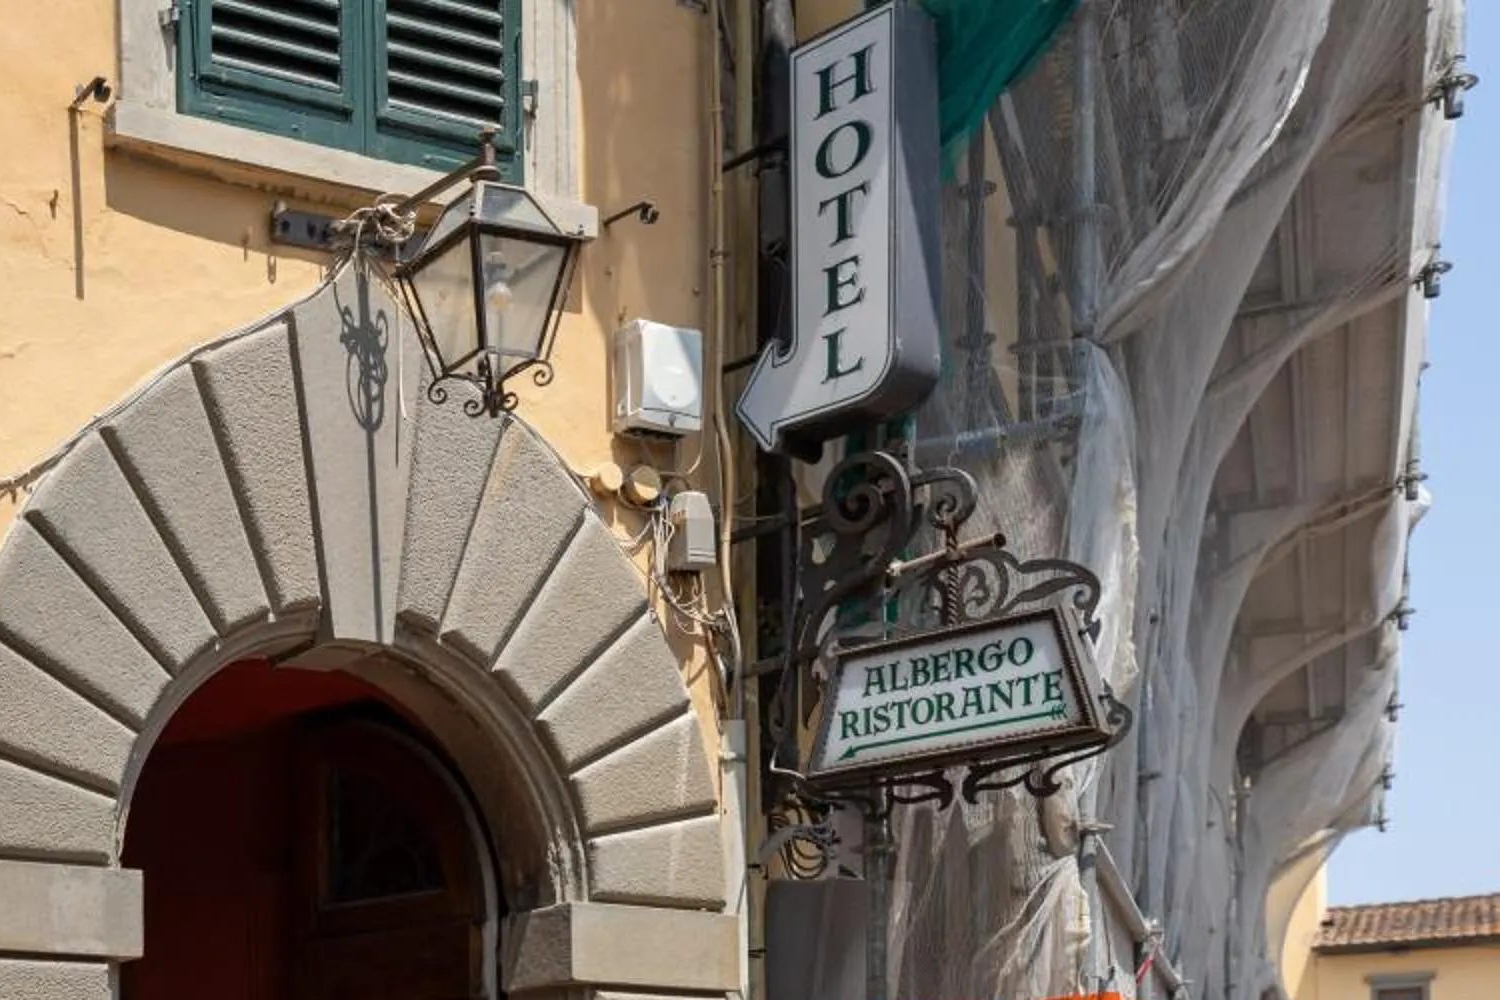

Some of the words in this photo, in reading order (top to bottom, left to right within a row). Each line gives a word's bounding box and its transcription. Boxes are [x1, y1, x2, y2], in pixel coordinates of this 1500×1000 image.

[813, 43, 876, 385] HOTEL
[862, 636, 1034, 698] ALBERGO
[838, 668, 1064, 740] RISTORANTE
